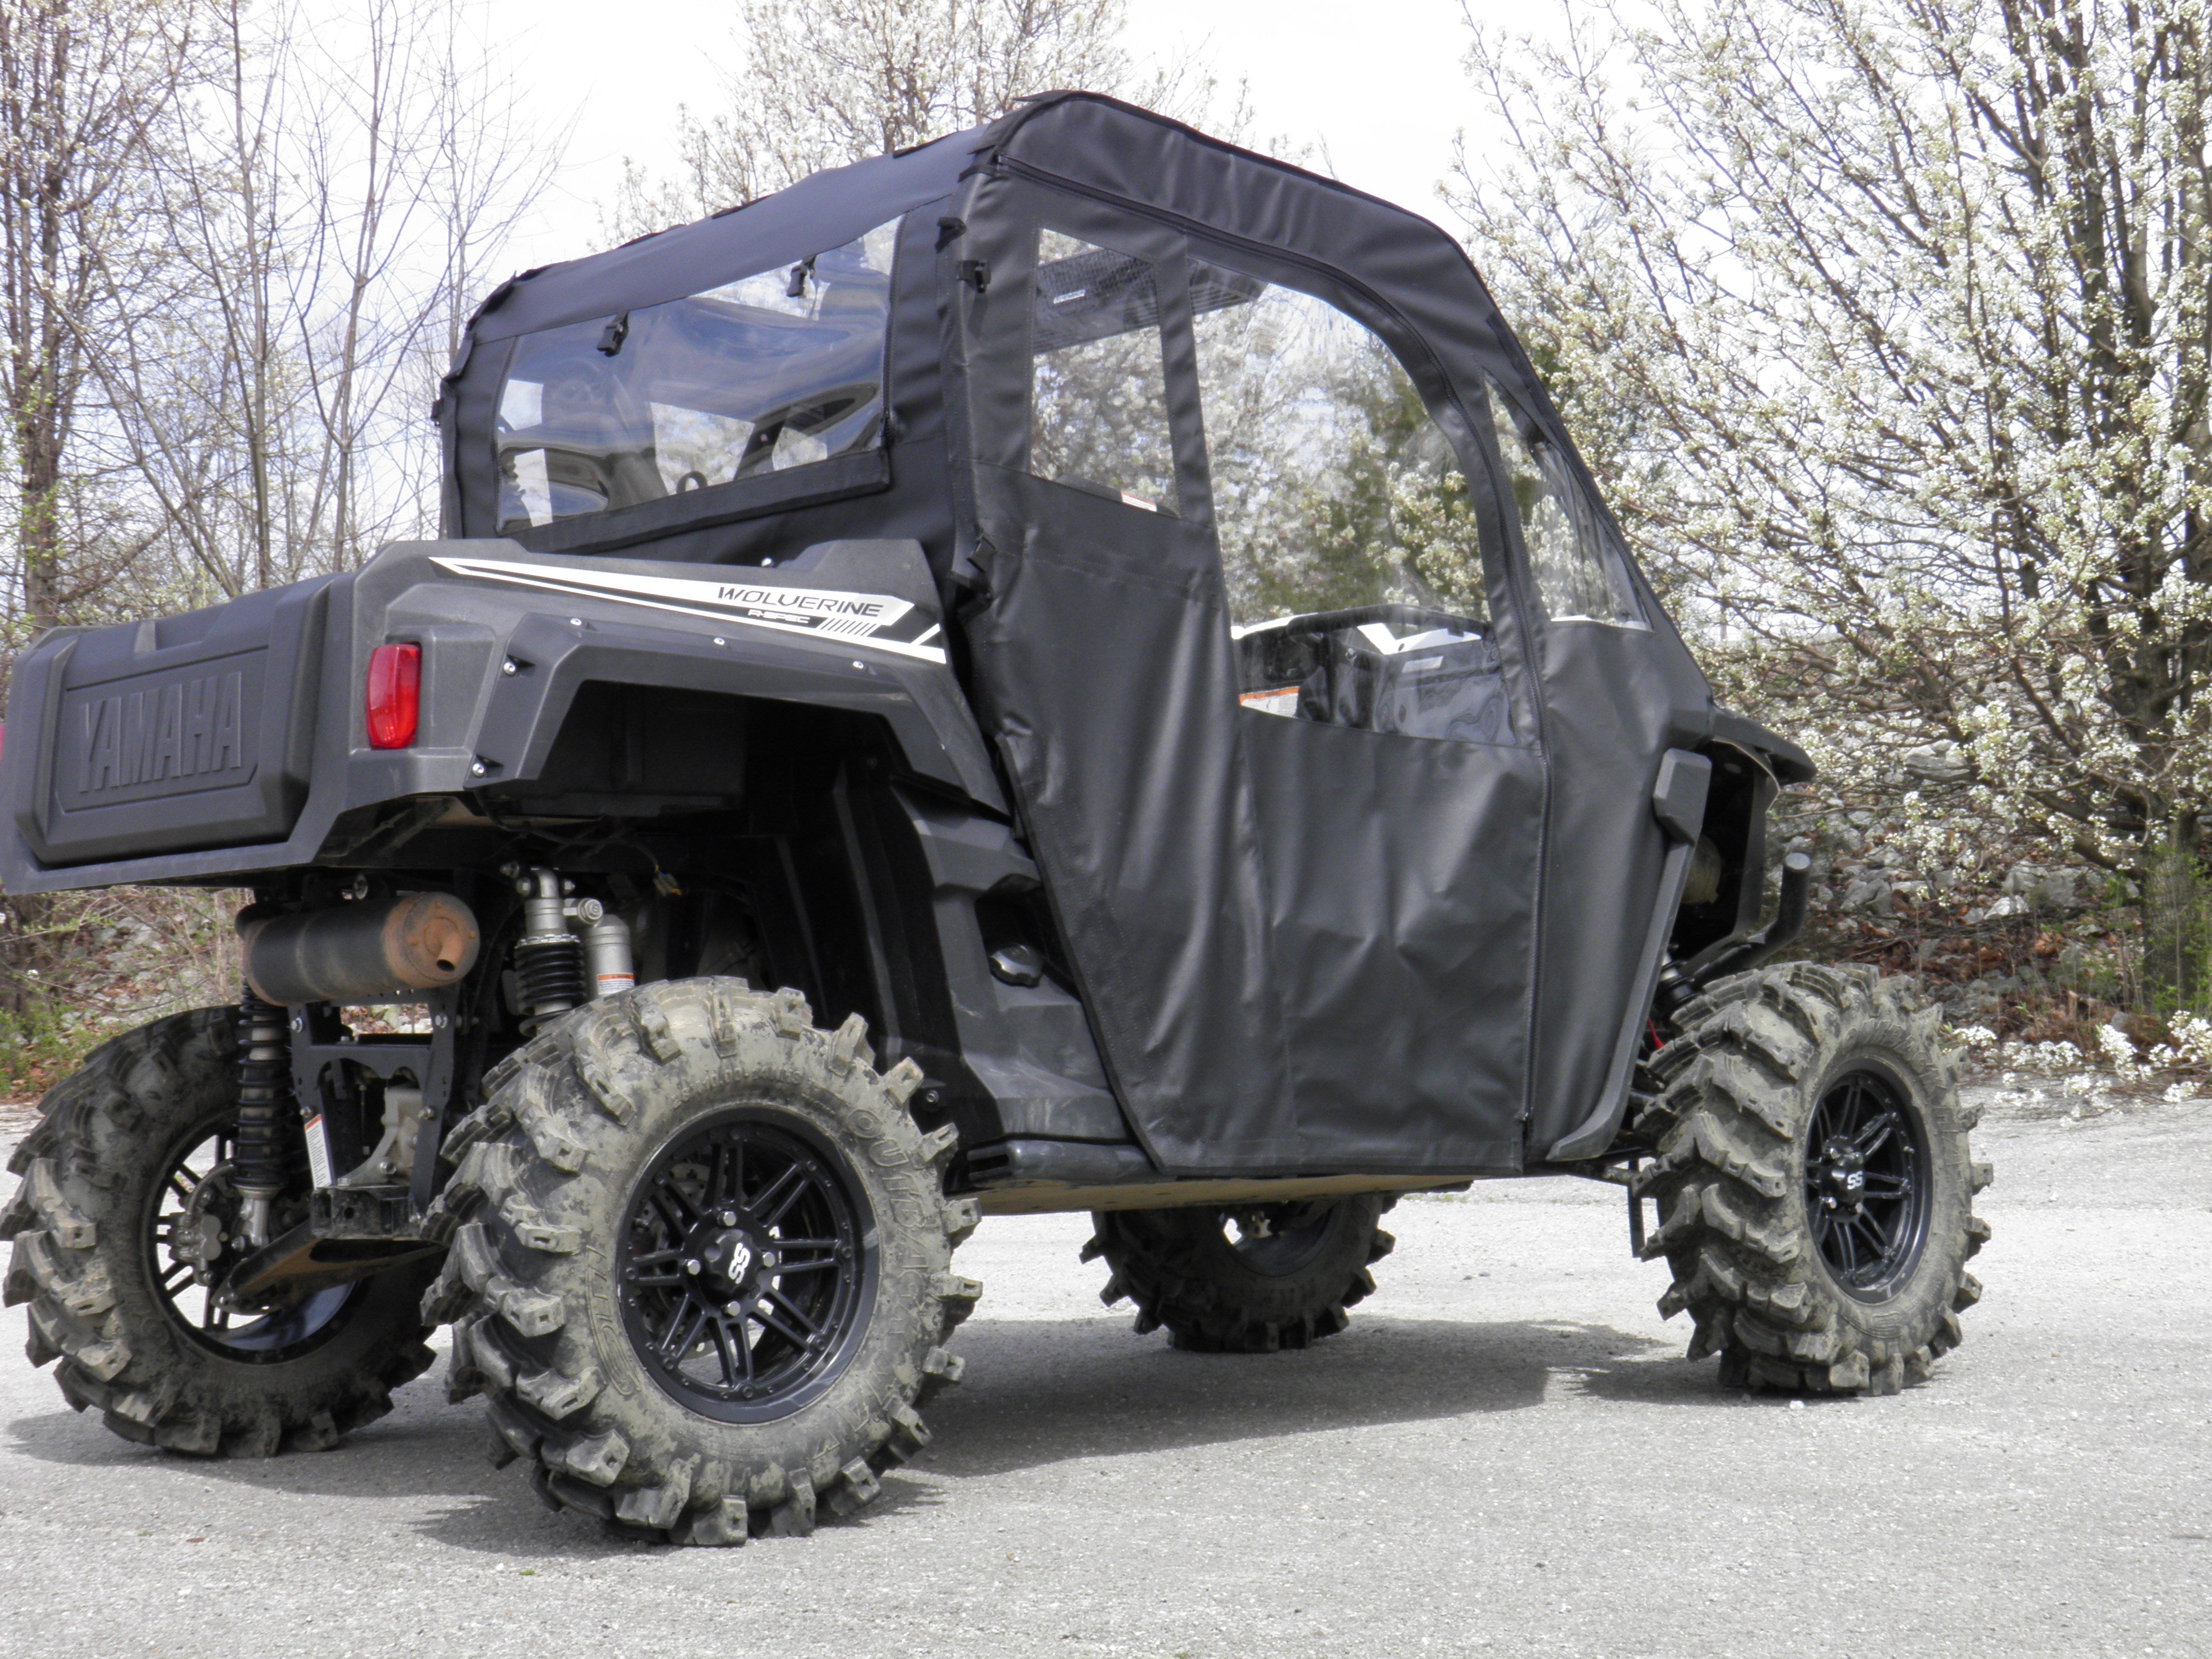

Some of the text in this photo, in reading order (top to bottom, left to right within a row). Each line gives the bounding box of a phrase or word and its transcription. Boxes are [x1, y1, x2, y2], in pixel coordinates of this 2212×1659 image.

[718, 586, 884, 617] WOLVERINE
[78, 671, 242, 793] YAMAHA
[1847, 1170, 1863, 1190] SS
[728, 1242, 751, 1284] SS
